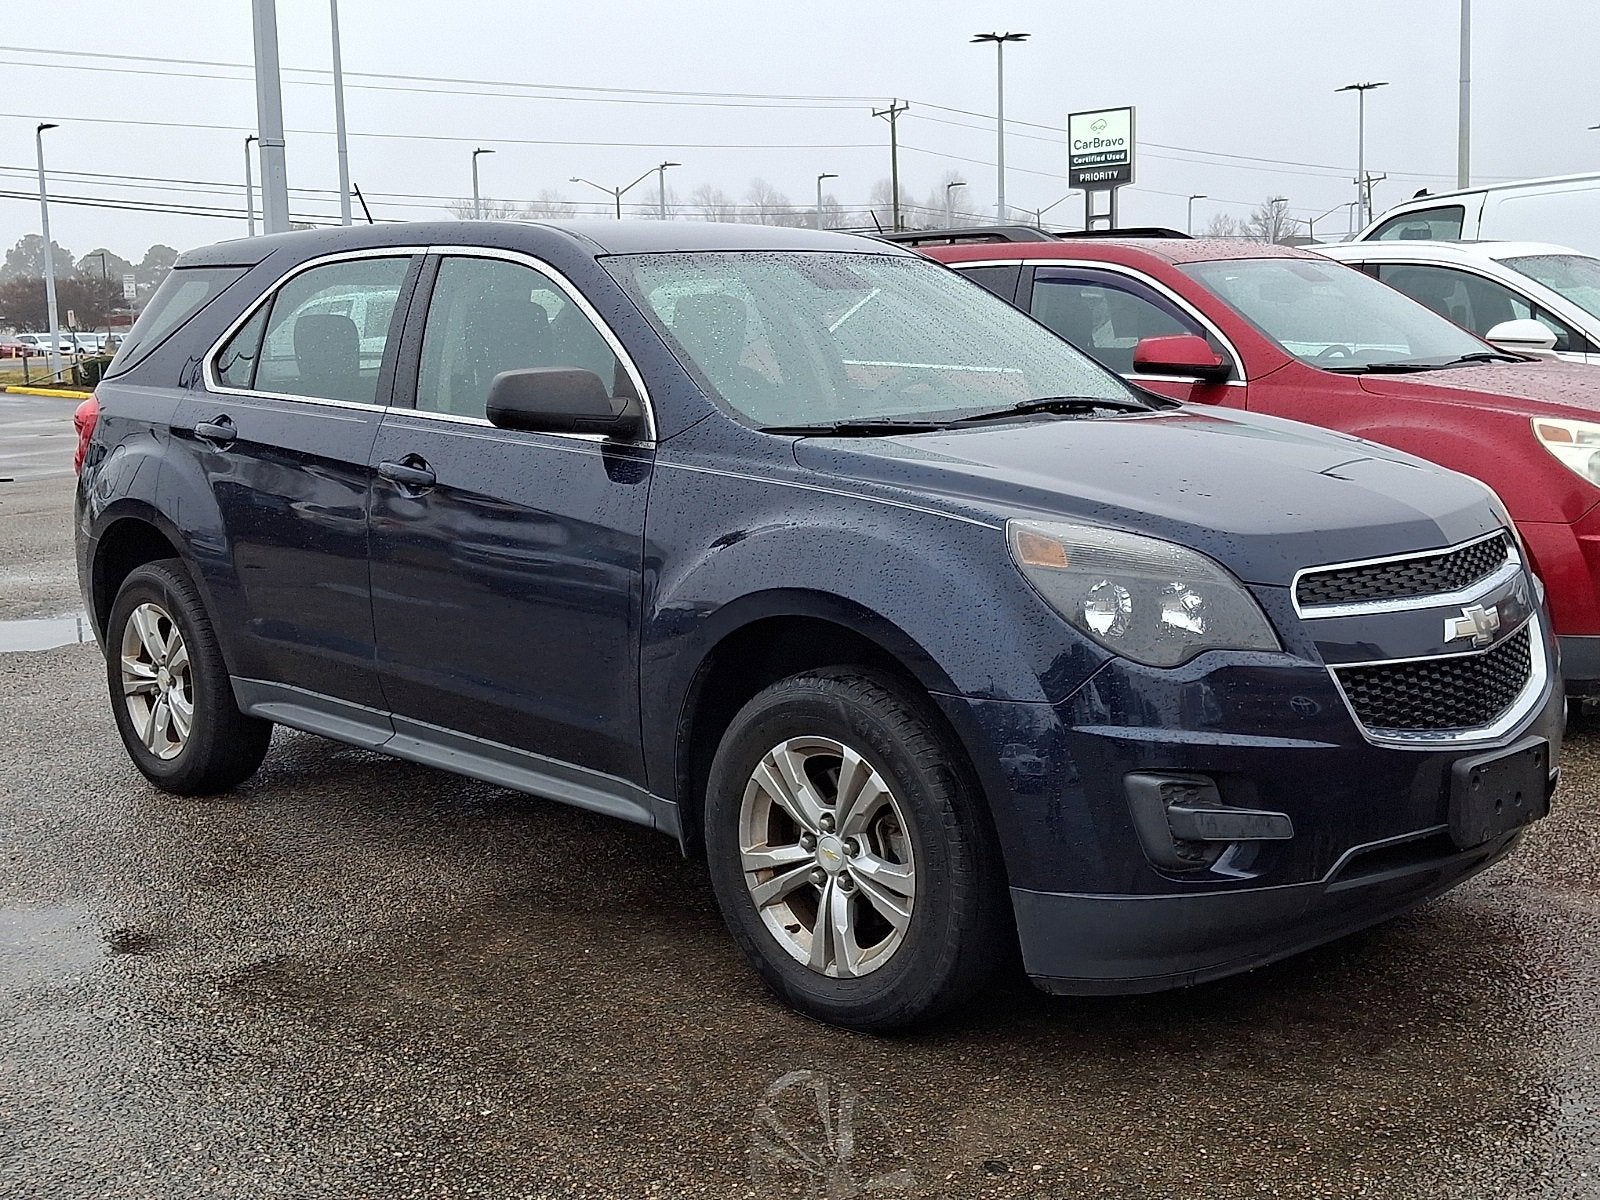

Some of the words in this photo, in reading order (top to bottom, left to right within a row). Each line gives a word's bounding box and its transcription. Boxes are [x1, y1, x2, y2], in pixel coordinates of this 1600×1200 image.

[1074, 138, 1124, 150] CarBravo
[1073, 154, 1106, 164] Certified
[1107, 152, 1125, 161] Used
[1080, 170, 1119, 182] PRIORITY
